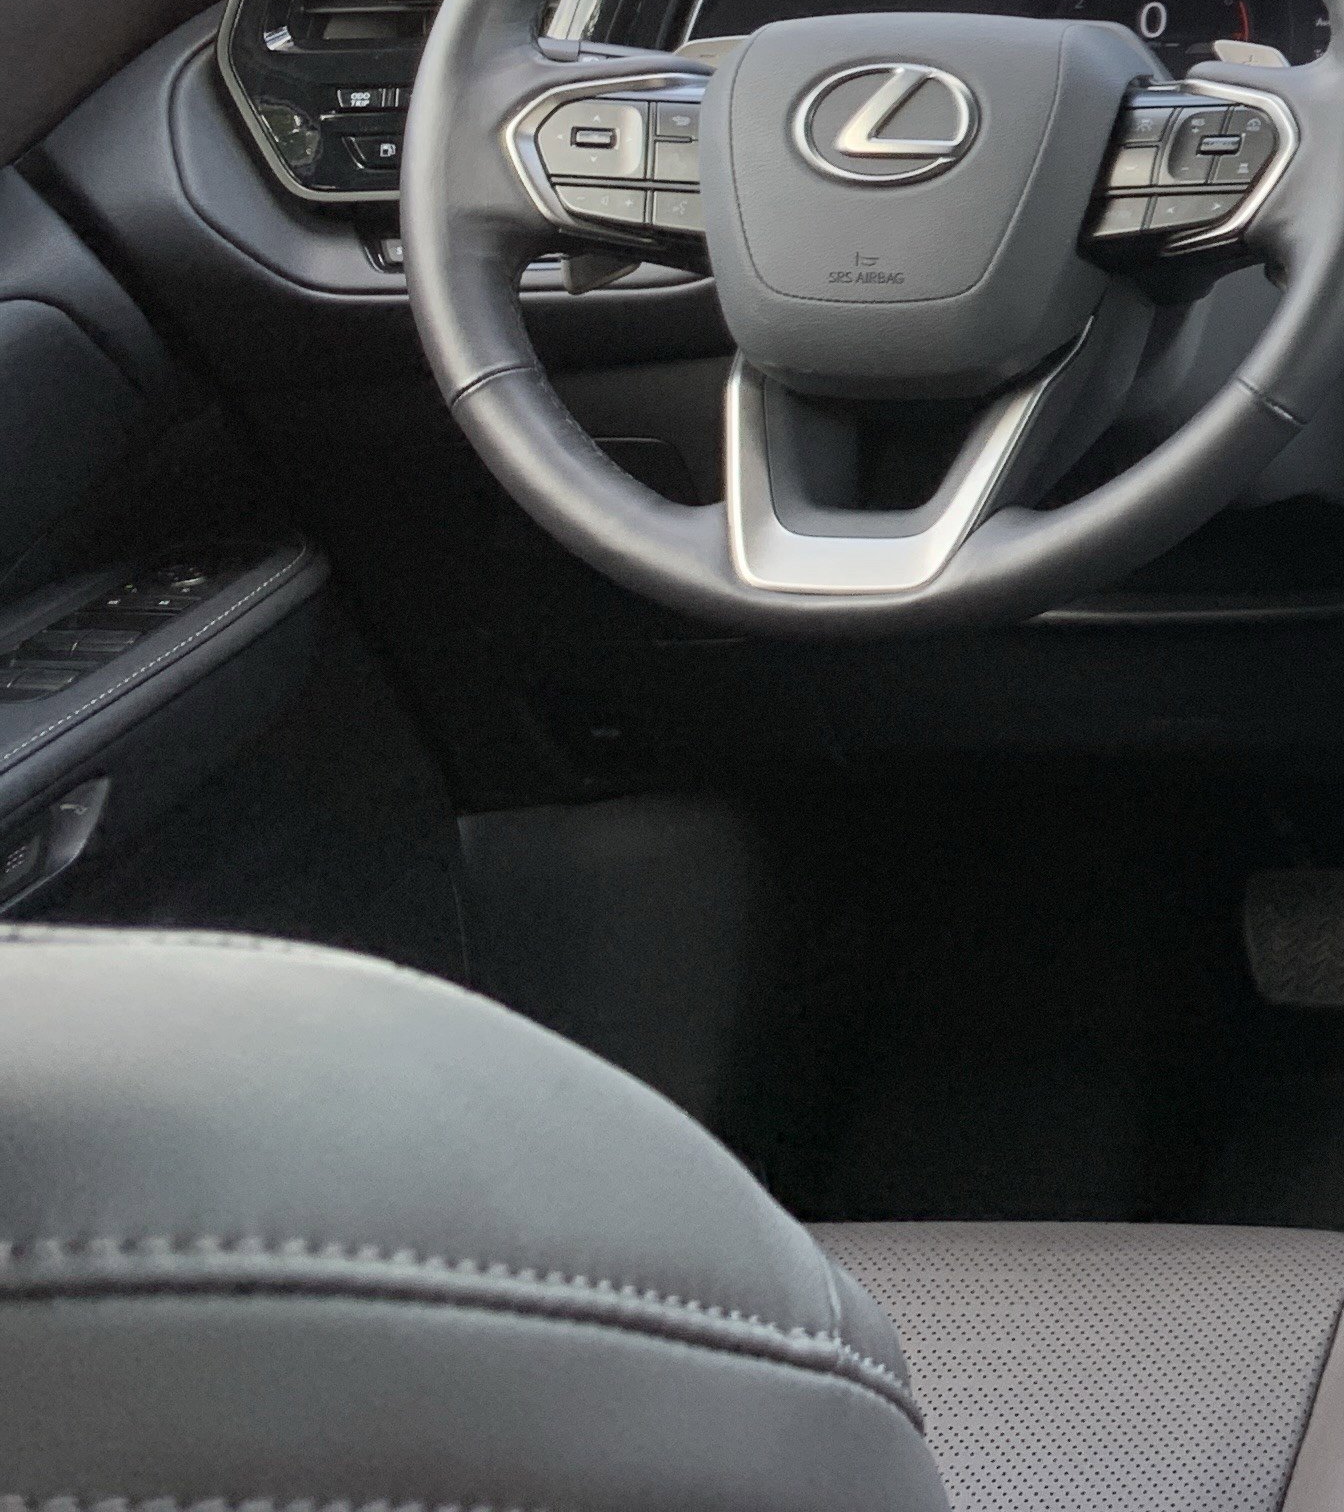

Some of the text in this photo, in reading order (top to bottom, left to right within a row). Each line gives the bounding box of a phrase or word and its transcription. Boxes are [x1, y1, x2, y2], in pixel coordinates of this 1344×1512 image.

[1139, 0, 1168, 40] 0
[350, 91, 371, 100] ODO
[350, 99, 370, 108] TRIP
[828, 270, 905, 285] SRS AIRBAG
